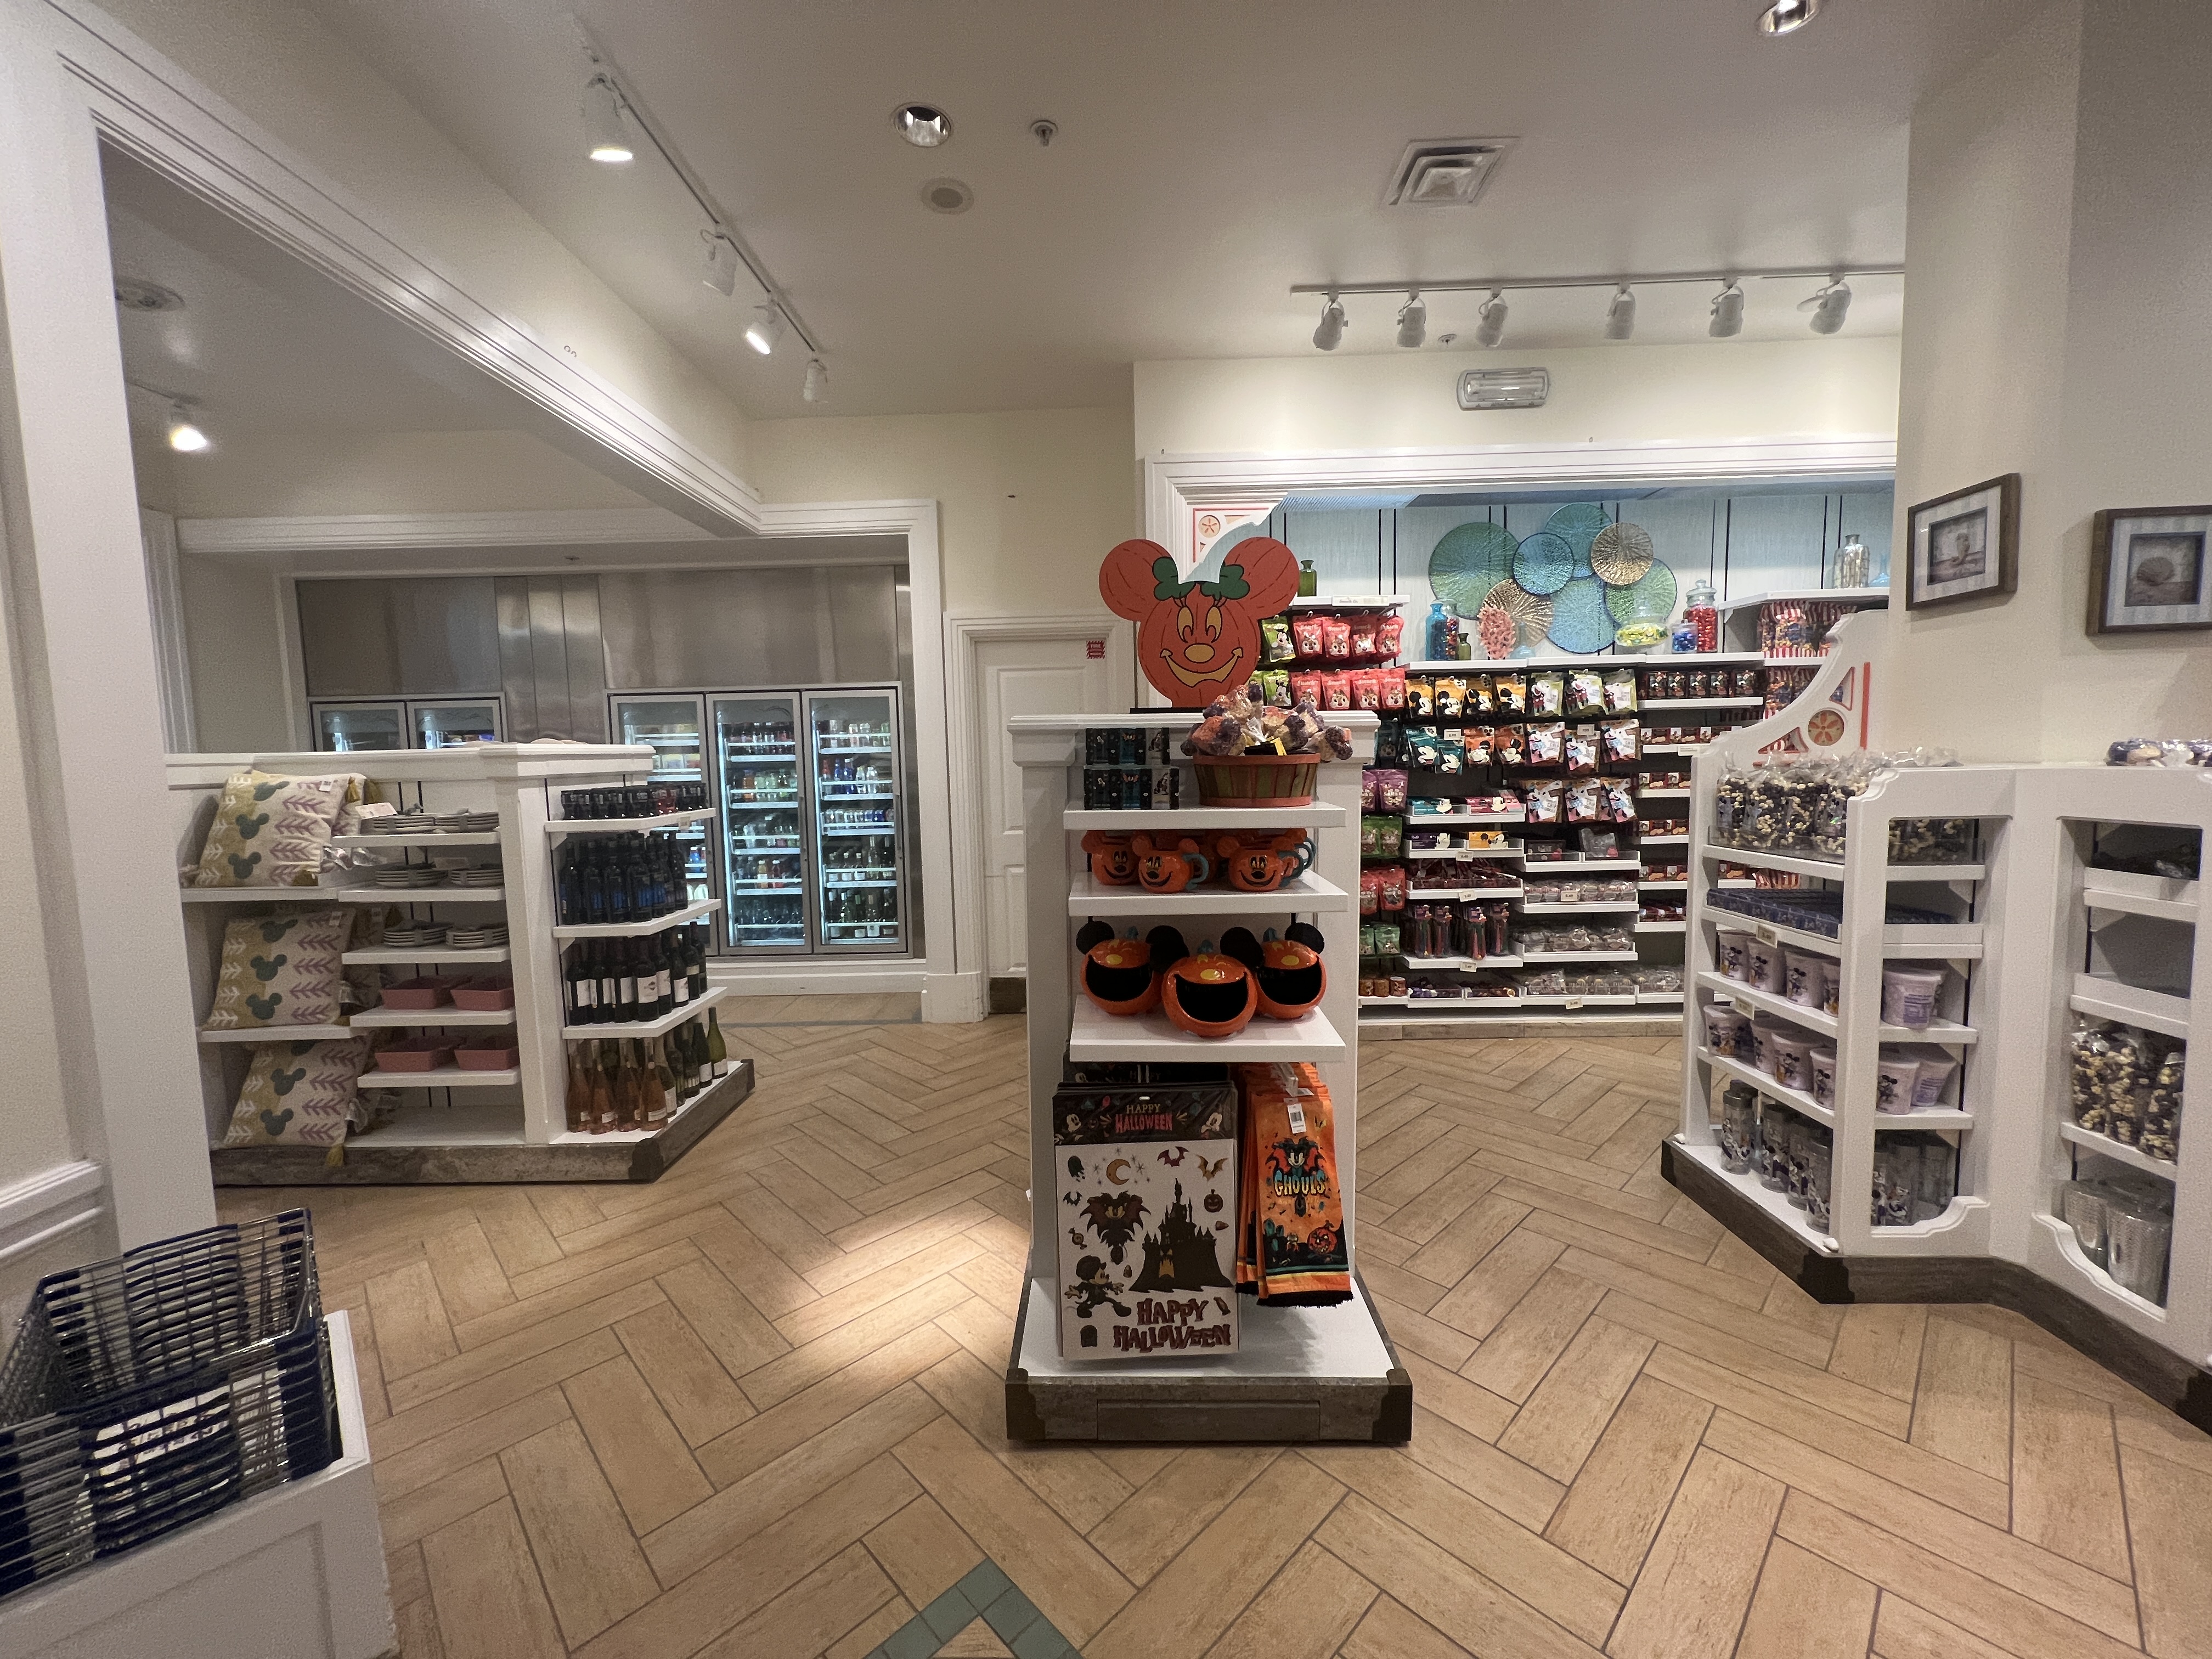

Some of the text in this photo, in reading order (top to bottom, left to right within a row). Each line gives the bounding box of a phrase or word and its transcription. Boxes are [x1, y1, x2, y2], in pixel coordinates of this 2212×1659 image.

[1126, 1103, 1161, 1114] HAPPY
[1115, 1113, 1172, 1133] HALLOWEEN
[1274, 1170, 1325, 1196] GHOULS
[1137, 1298, 1209, 1327] HAPPY
[1113, 1324, 1231, 1353] HALLOWEEN
